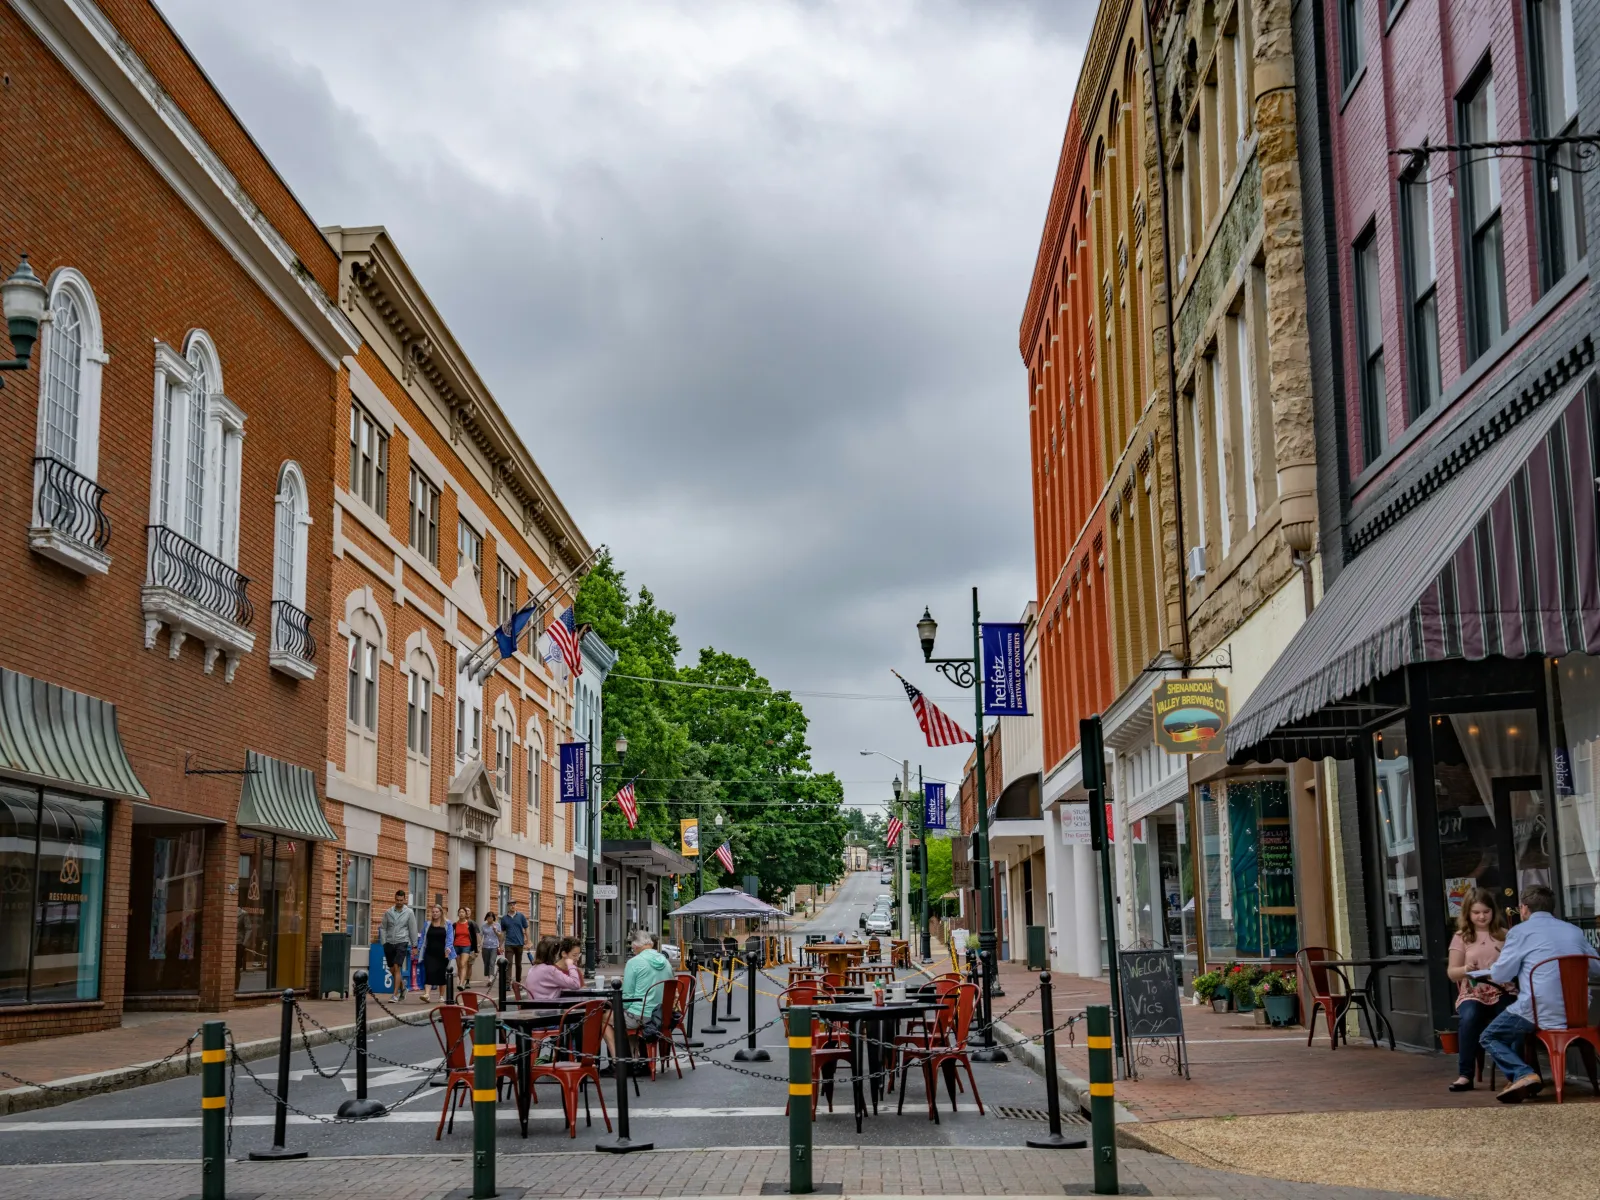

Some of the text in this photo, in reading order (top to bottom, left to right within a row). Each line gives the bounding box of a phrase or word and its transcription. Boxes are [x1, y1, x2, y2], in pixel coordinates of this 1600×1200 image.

[990, 655, 1006, 708] heifetz
[1015, 668, 1020, 677] OF
[1167, 682, 1214, 694] SHENANDOAH
[1156, 695, 1226, 715] VALLEY BREWING CO.
[563, 763, 574, 798] heifetz
[928, 798, 936, 824] heifetz
[49, 892, 88, 902] RESTORATION
